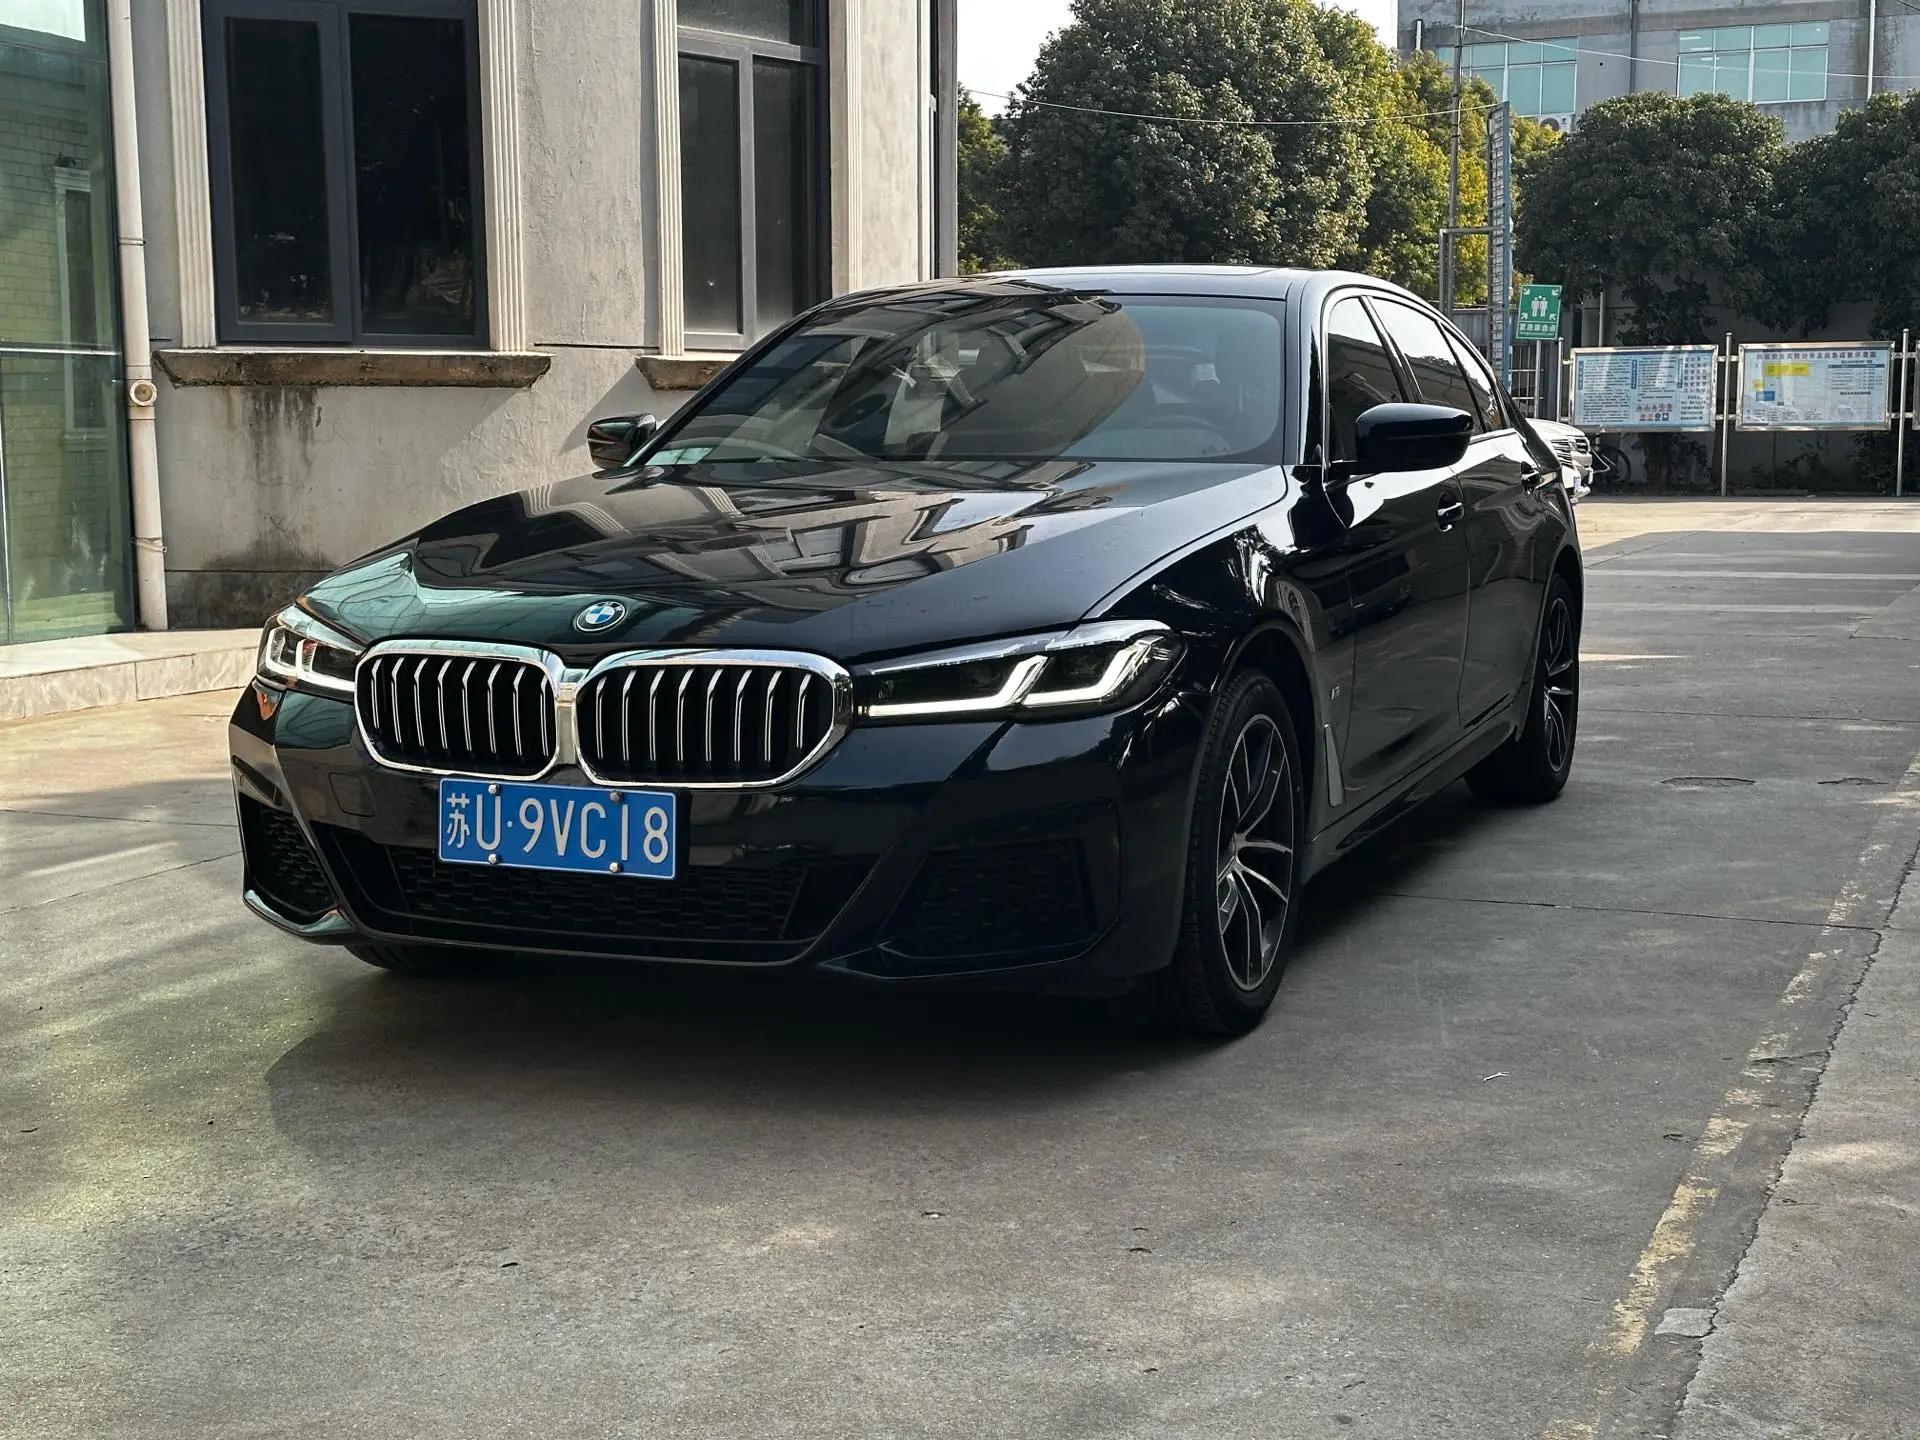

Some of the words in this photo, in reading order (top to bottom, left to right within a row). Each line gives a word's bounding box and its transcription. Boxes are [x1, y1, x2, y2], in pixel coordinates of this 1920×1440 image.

[1519, 323, 1556, 332] 紧急集合点
[446, 792, 670, 864] 苏U·9VC18
